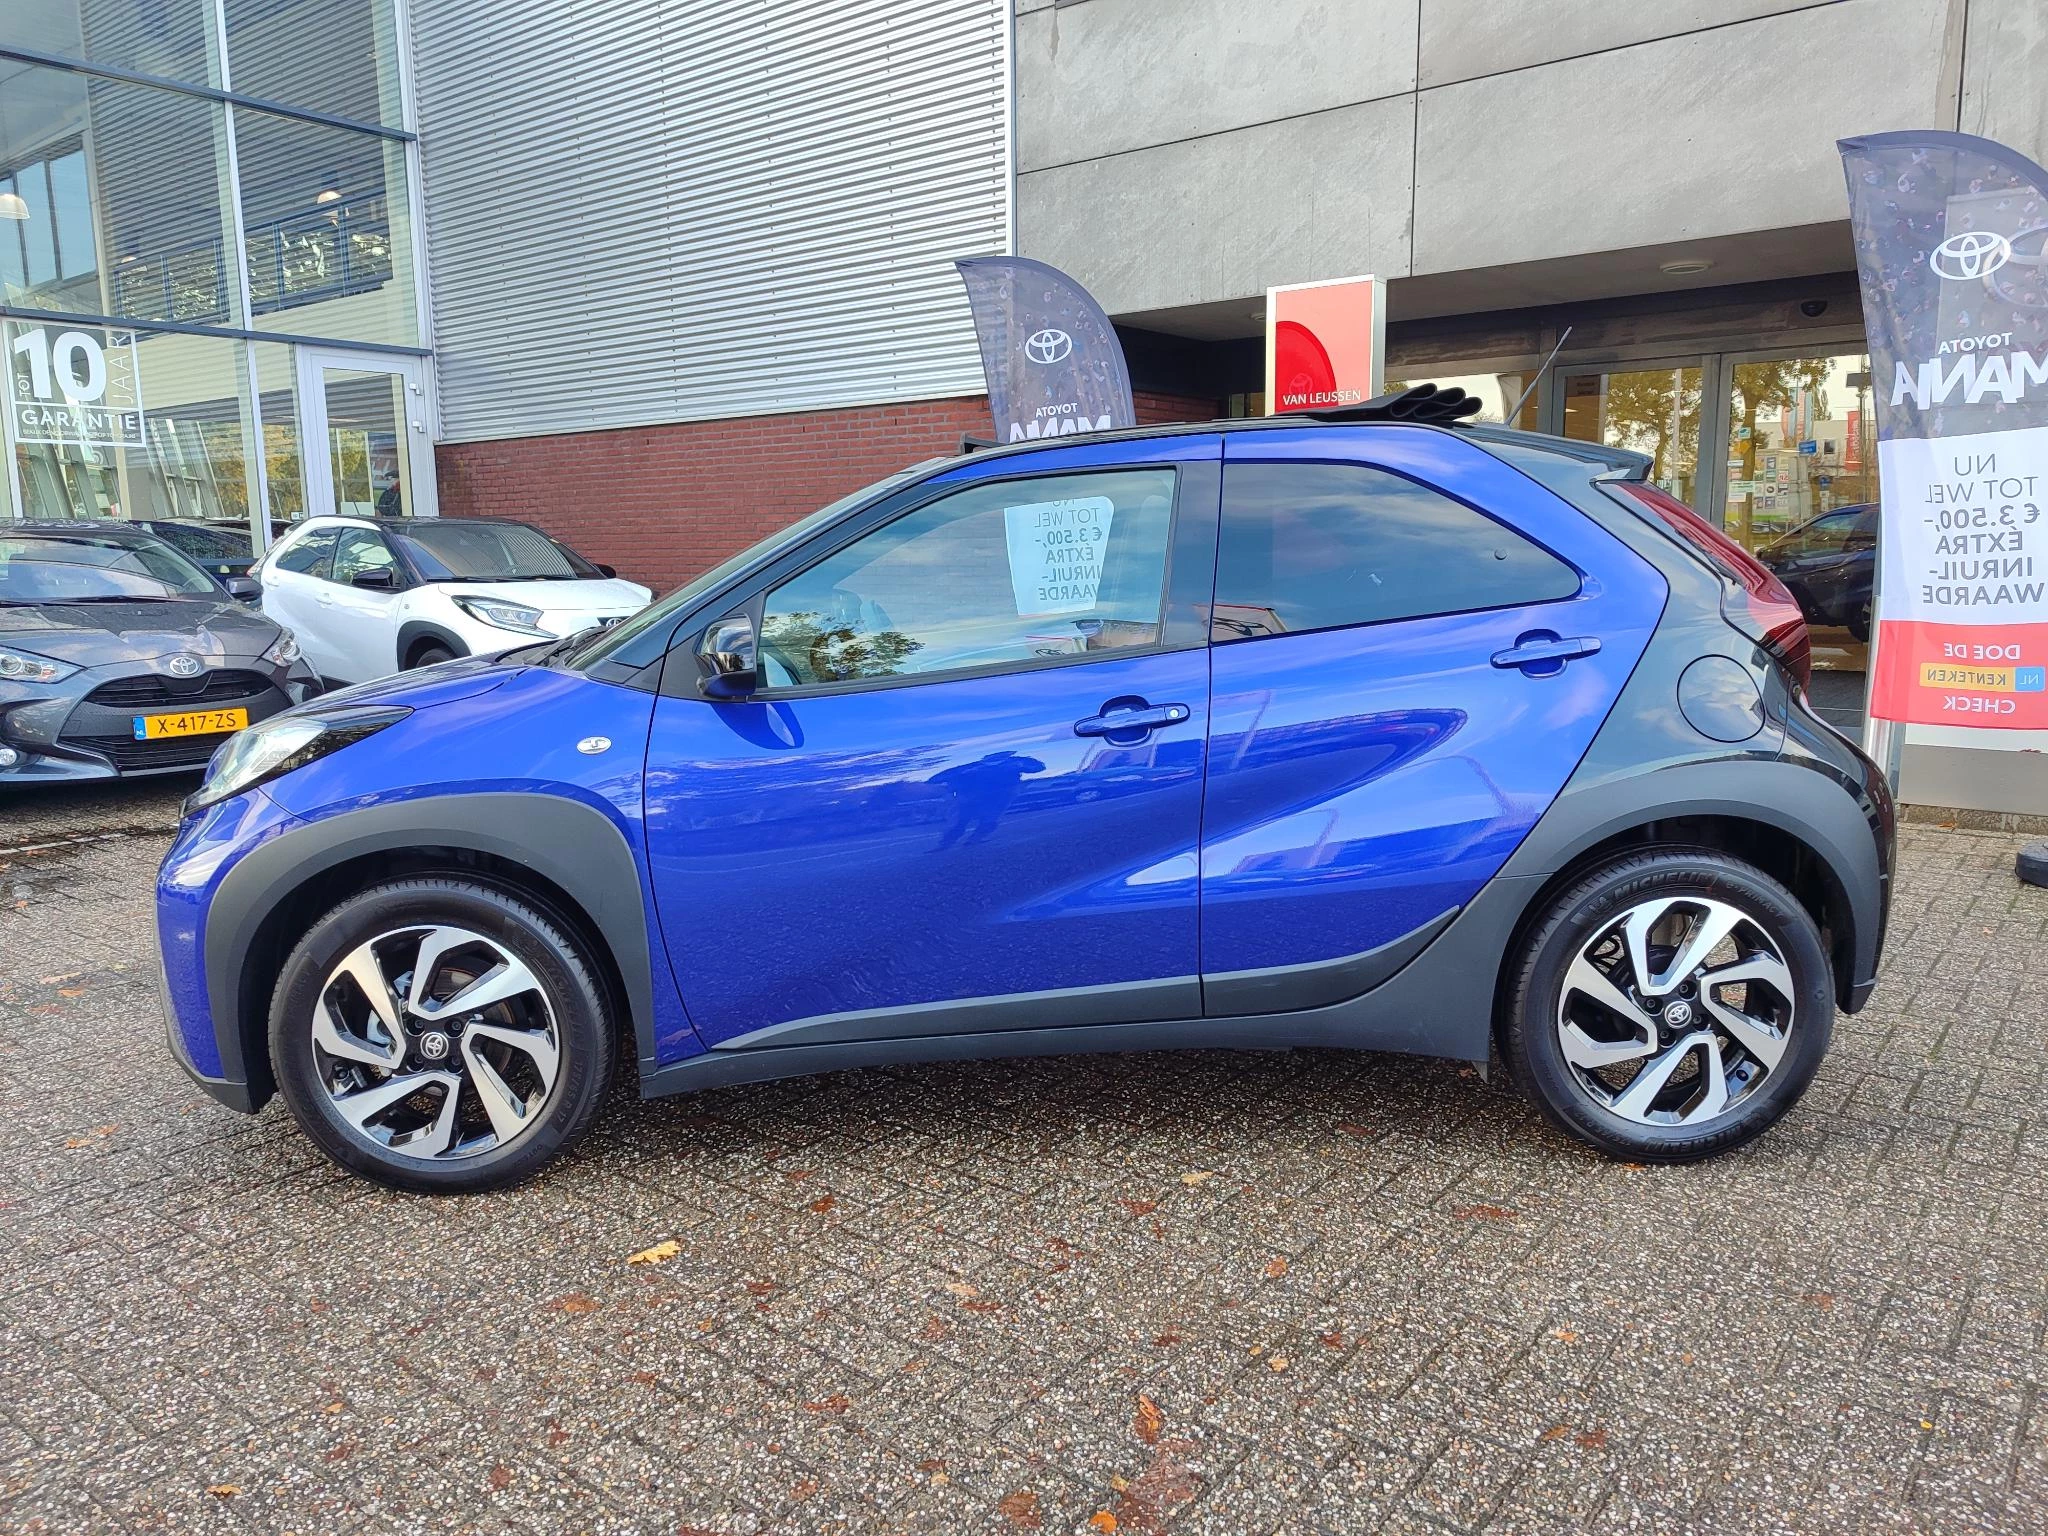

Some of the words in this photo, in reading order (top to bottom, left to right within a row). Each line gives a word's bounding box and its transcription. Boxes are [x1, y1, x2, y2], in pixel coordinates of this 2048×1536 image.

[13, 328, 107, 402] 10
[106, 336, 134, 405] JAAR
[17, 372, 31, 397] TOT
[1283, 393, 1306, 406] VAN
[1309, 389, 1361, 404] LEUSSEN
[21, 409, 136, 430] GARANTIE
[157, 712, 237, 735] X-417-ZS
[1613, 869, 1714, 900] MICHELIN
